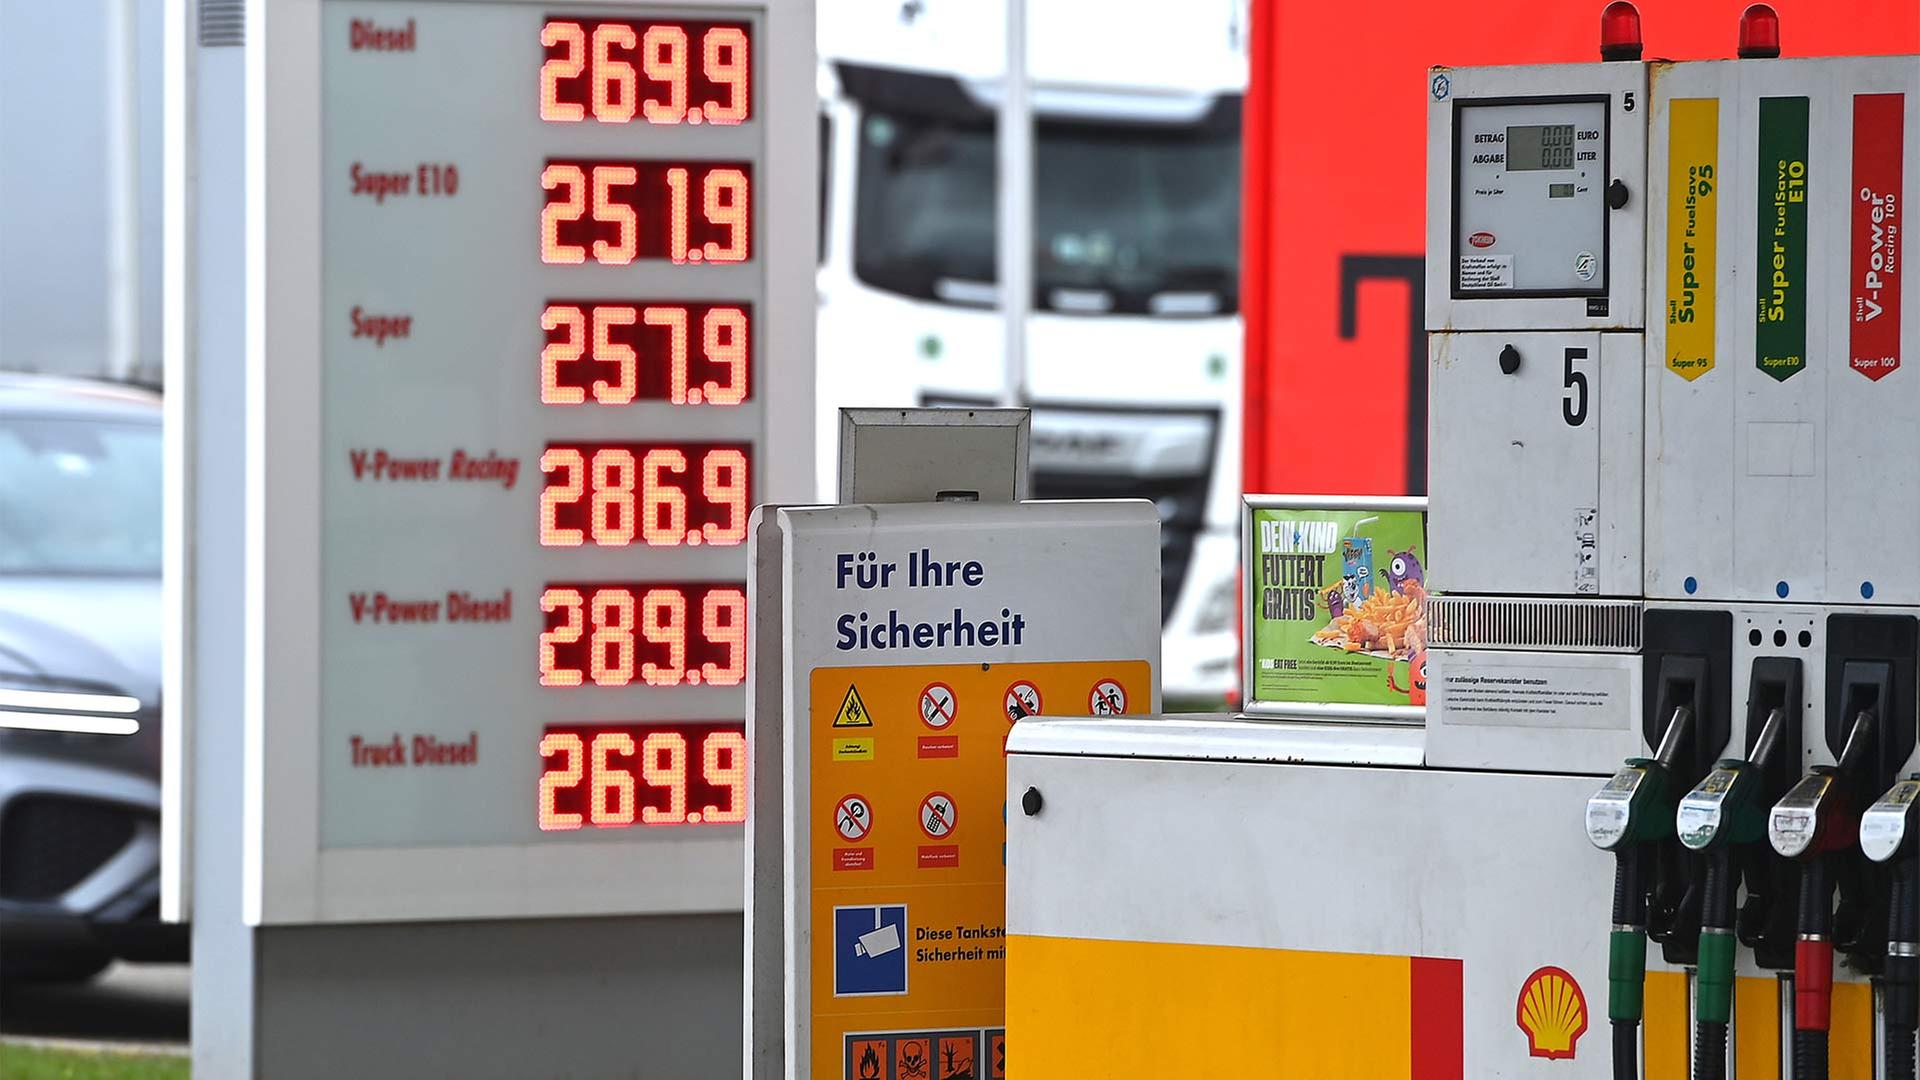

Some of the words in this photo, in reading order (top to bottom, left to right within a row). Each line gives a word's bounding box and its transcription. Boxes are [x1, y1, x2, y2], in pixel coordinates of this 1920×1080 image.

[350, 18, 416, 51] Diesel
[540, 22, 748, 126] 269.9
[1623, 92, 1636, 112] 5
[1474, 133, 1505, 144] BETRAG
[1577, 130, 1599, 141] EURO
[1577, 151, 1597, 161] LITER
[1472, 154, 1505, 164] ABGABE
[350, 164, 412, 205] Super
[417, 164, 459, 196] E10
[1699, 164, 1713, 197] 95
[1774, 159, 1786, 237] FuelSave
[1788, 160, 1805, 204] E10
[540, 164, 748, 265] 251.9
[1686, 165, 1697, 238] FuelSave
[1884, 194, 1896, 218] 100
[1884, 225, 1897, 274] Racing
[1678, 241, 1699, 323] Super
[1768, 241, 1790, 322] Super
[350, 306, 412, 347] Super
[540, 306, 748, 405] 257.9
[1672, 358, 1695, 370] Super
[1697, 357, 1708, 367] 95
[1763, 356, 1787, 368] Super
[1854, 357, 1877, 369] Super
[1880, 356, 1895, 367] 100
[1562, 348, 1589, 427] 5
[350, 449, 440, 482] V-Power
[448, 449, 521, 490] Racing
[539, 448, 747, 547] 286.9
[1260, 520, 1295, 553] DEIN
[1298, 521, 1339, 554] KIND
[836, 551, 897, 590] Für
[908, 548, 984, 587] Ihre
[1262, 554, 1326, 588] FUTTERT
[350, 592, 440, 624] V-Power
[447, 590, 512, 623] Diesel
[539, 589, 746, 687] 289.9
[836, 608, 1026, 651] Sicherheit
[350, 734, 405, 768] Truck
[412, 732, 478, 766] Diesel
[539, 732, 748, 831] 269.9
[915, 926, 953, 941] Diese
[916, 946, 984, 962] Sicherheit
